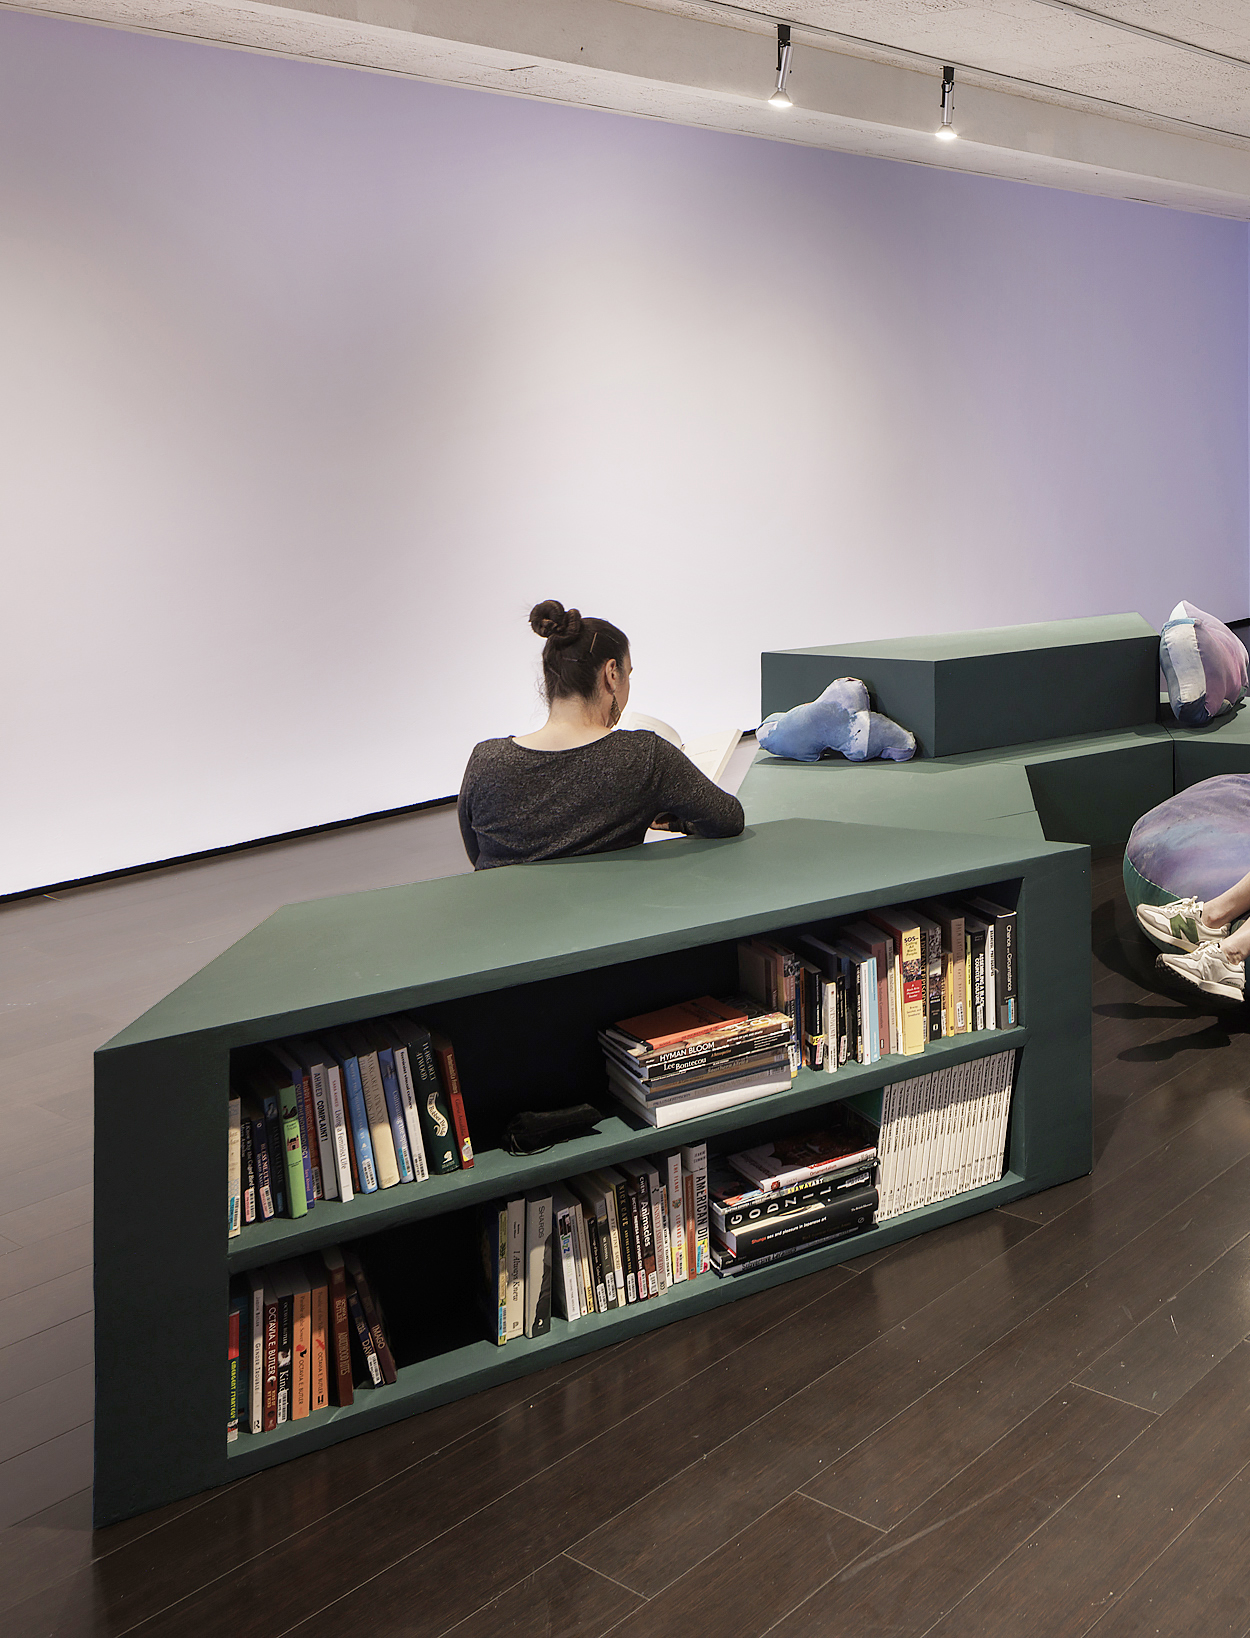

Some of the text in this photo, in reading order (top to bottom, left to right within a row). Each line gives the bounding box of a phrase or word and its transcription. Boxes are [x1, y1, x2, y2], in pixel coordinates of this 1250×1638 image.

[1170, 914, 1199, 943] N
[1005, 952, 1014, 991] Circumstance
[421, 1041, 436, 1081] MARGARET
[658, 1040, 715, 1062] HYMAN BLOOM
[661, 1056, 707, 1071] Lee Bontecou
[399, 1051, 408, 1074] feminist
[406, 1090, 414, 1110] culture
[415, 1051, 428, 1081] ATWOOD
[294, 1083, 303, 1102] QUEER
[365, 1055, 386, 1123] MARGARET ATWOOD
[426, 1093, 436, 1105] The
[313, 1072, 328, 1141] AHMED COMPLAINT!
[333, 1109, 343, 1127] Living
[390, 1089, 403, 1123] Cultivating
[397, 1123, 405, 1134] the
[296, 1104, 309, 1159] PHENOMENOLOGY
[336, 1132, 346, 1157] Feminist
[246, 1159, 254, 1174] Caged
[339, 1157, 347, 1169] Life
[808, 1163, 837, 1176] Ornamentalism
[247, 1174, 255, 1186] Bird
[638, 1176, 646, 1193] CHEN
[617, 1185, 629, 1227] NICK CAVE
[693, 1175, 709, 1241] AMERICAN DI
[537, 1205, 545, 1238] SHARDS
[609, 1218, 618, 1248] BYZANTINE
[639, 1200, 653, 1247] Animacies
[750, 1235, 767, 1245] Shunga
[781, 1224, 799, 1235] pleasure
[802, 1217, 821, 1228] Japanese
[560, 1234, 572, 1253] Jazz
[654, 1229, 662, 1244] FIRST
[511, 1255, 520, 1279] Always
[656, 1244, 664, 1274] AMERICA'S
[511, 1280, 519, 1301] Knew
[238, 1324, 248, 1371] PLEASURE
[266, 1307, 277, 1375] OCTAVIA E. BUTLER
[360, 1338, 374, 1356] DAW
[371, 1323, 385, 1350] IMAGO
[337, 1331, 350, 1375] ADULTHOOD RITES
[228, 1360, 237, 1418] EMERGENT STRATEGY
